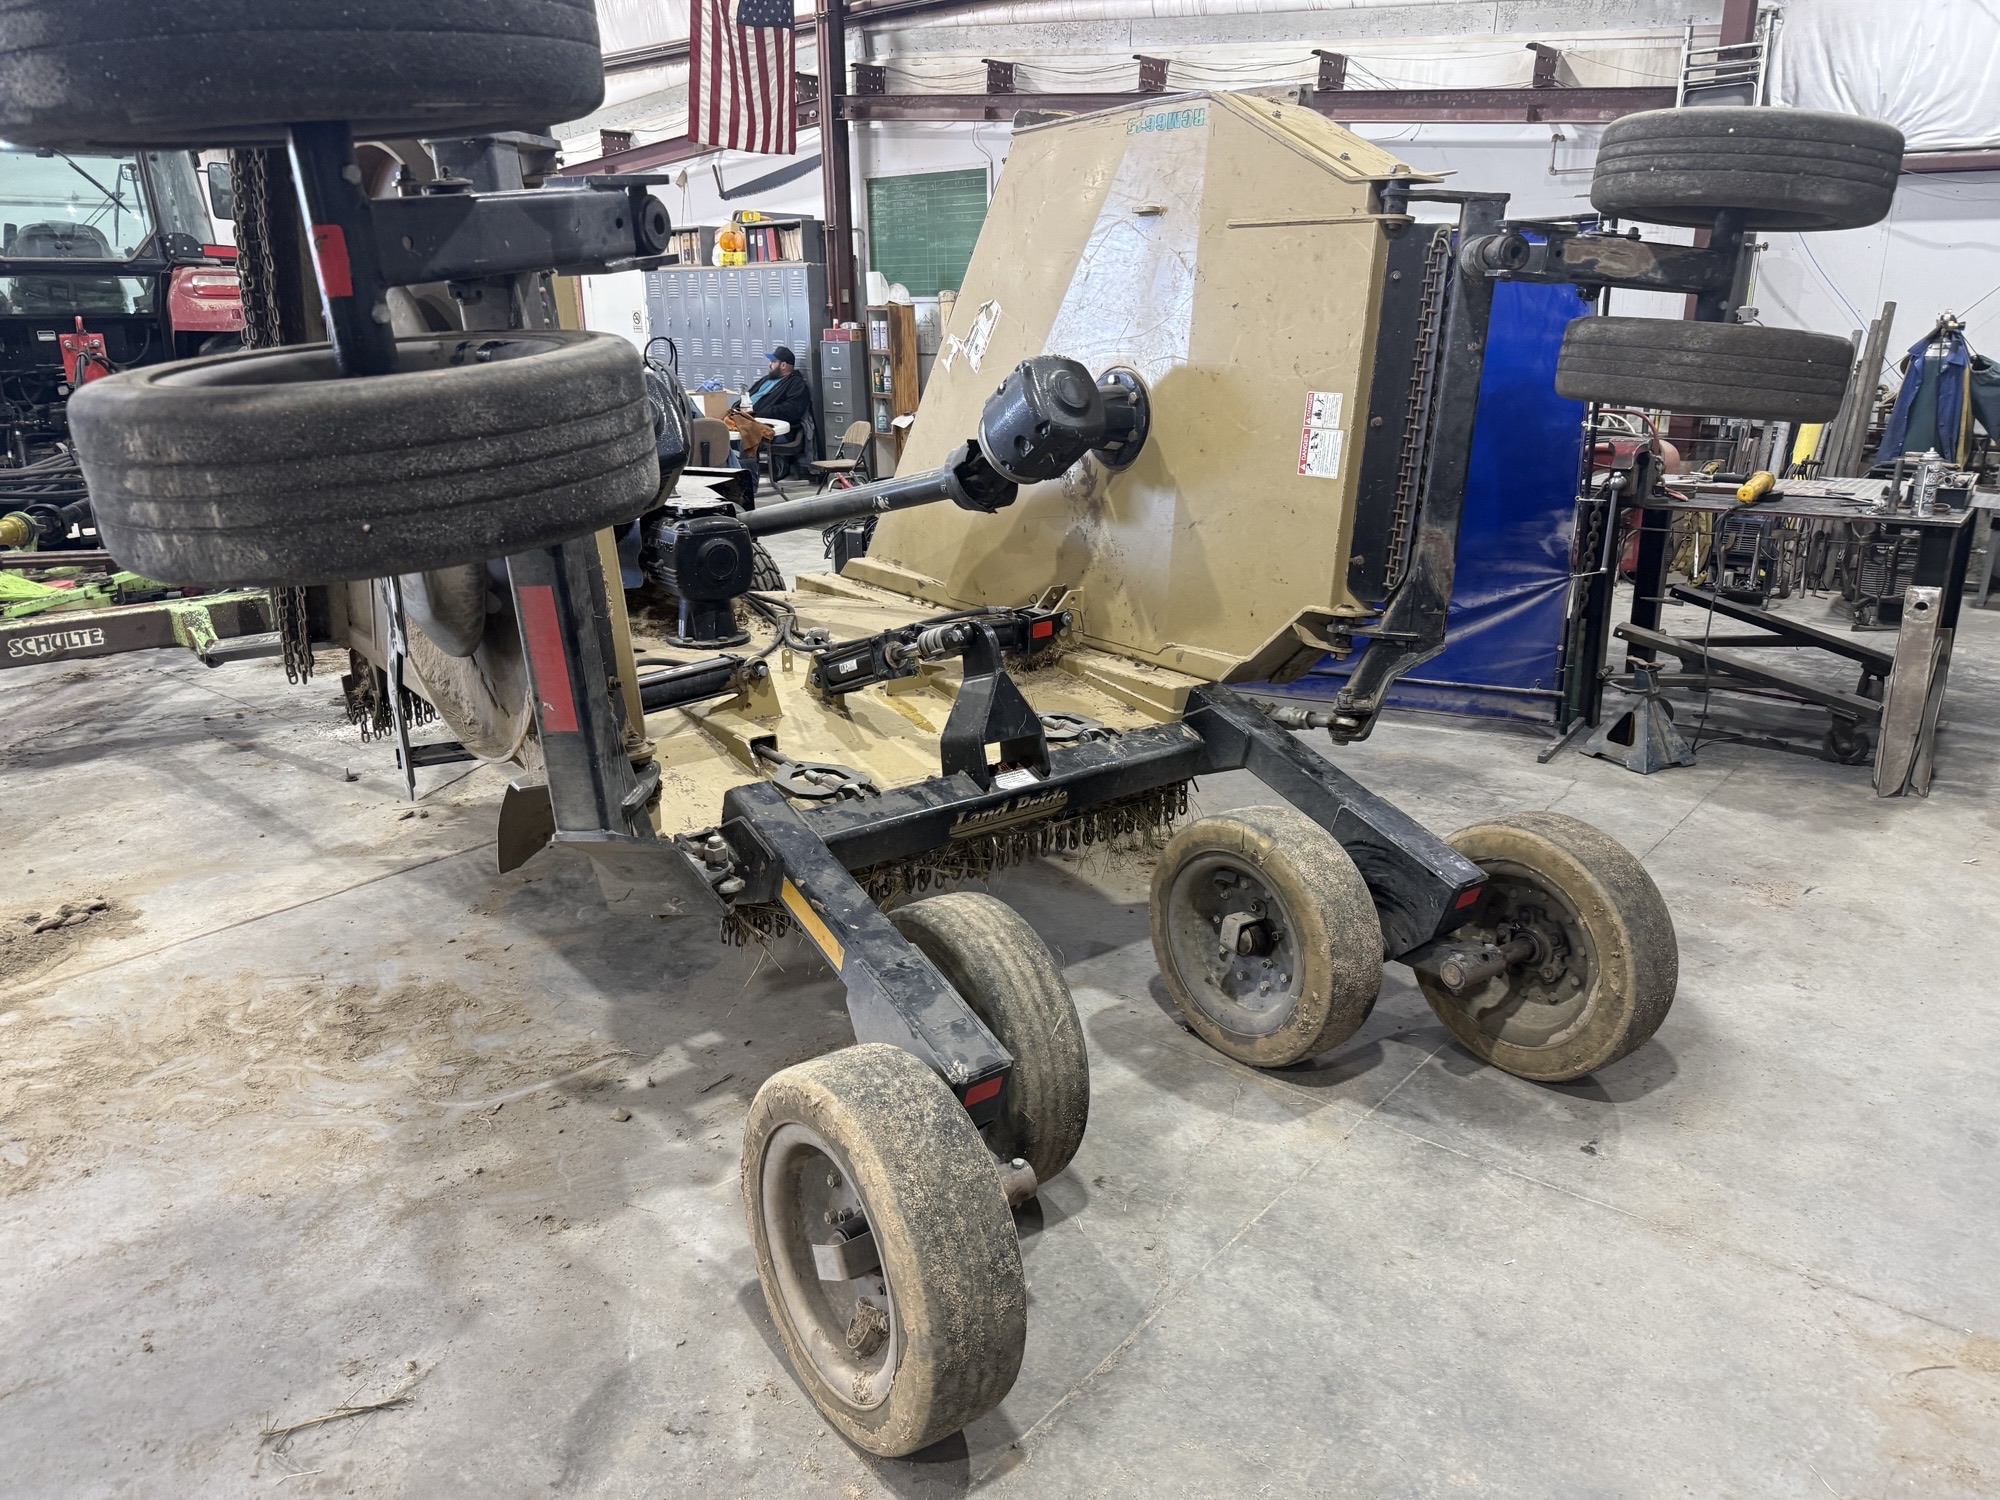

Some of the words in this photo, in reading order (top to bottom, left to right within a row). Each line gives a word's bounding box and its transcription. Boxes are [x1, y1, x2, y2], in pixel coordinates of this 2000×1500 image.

[8, 628, 104, 657] SCHULTE
[951, 801, 1010, 832] Land
[1013, 788, 1069, 814] Pride
